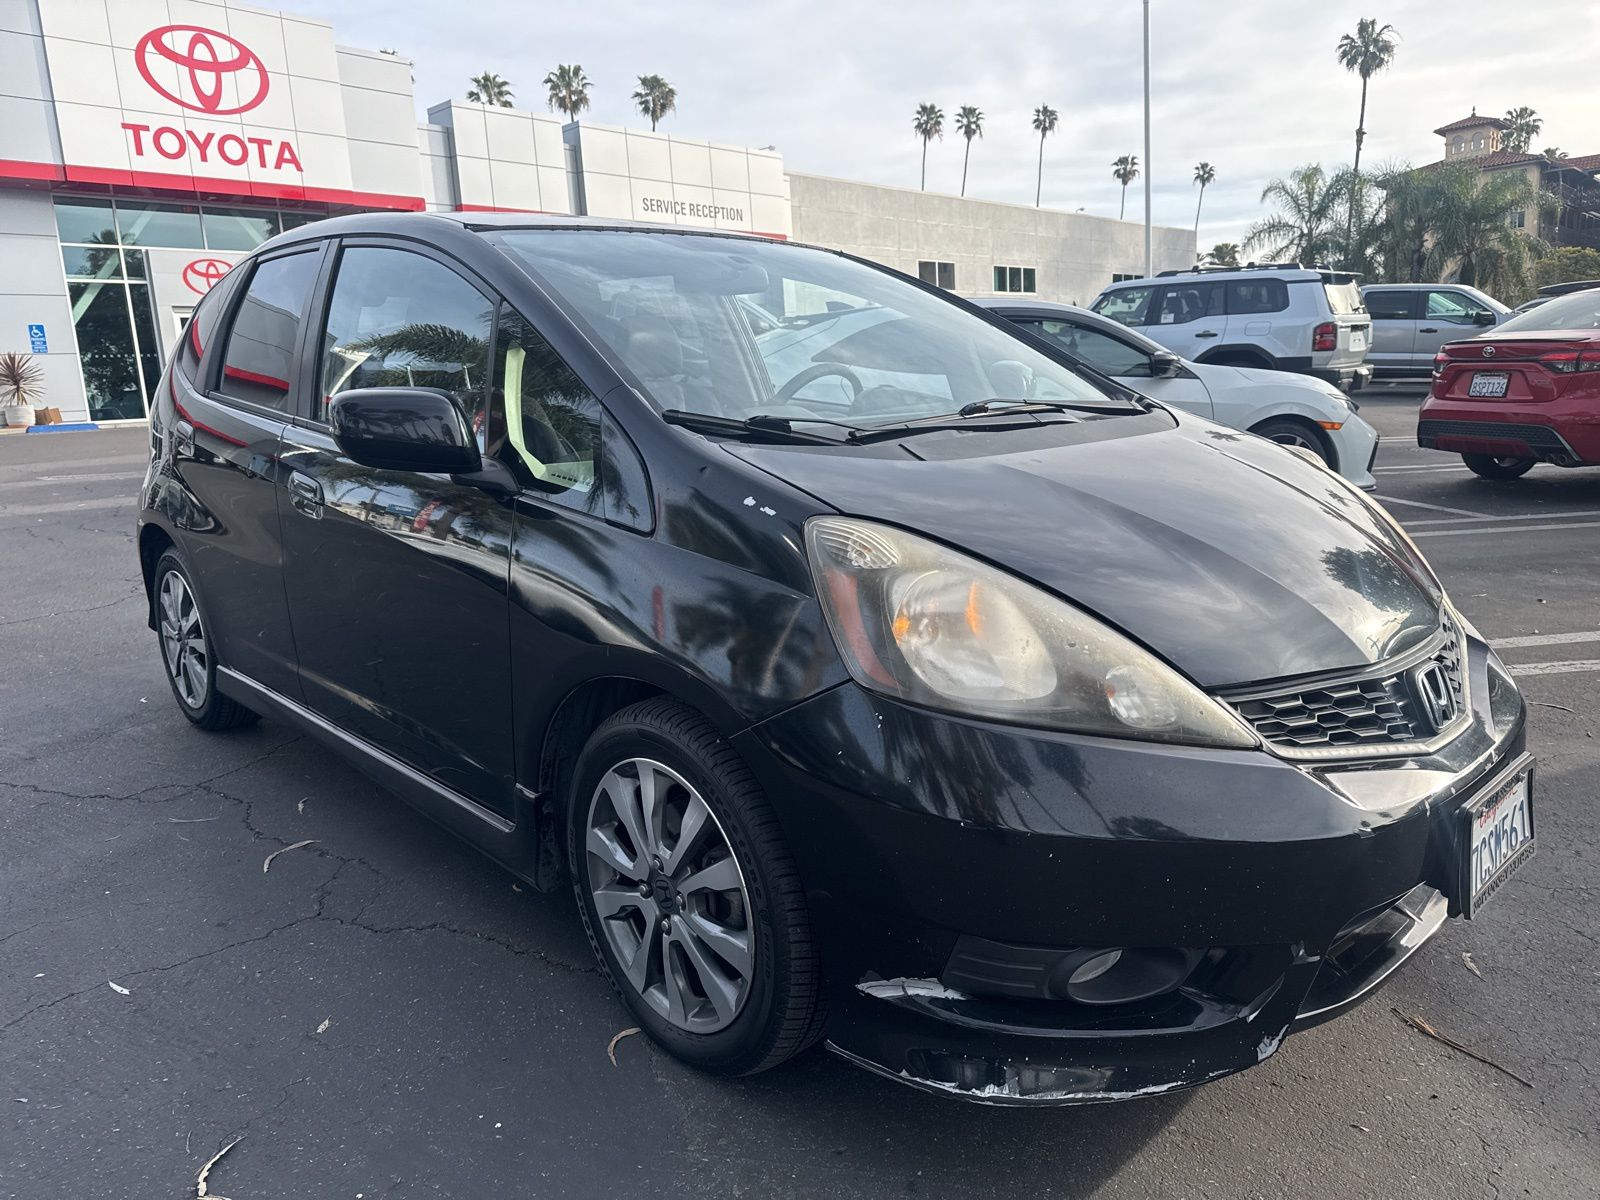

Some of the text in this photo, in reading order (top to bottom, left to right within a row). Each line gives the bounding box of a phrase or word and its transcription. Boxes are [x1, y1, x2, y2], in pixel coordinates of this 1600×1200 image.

[121, 122, 304, 173] TOYOTA
[642, 197, 744, 222] SERVICE RECEPTION
[1472, 799, 1531, 893] 7CSM561
